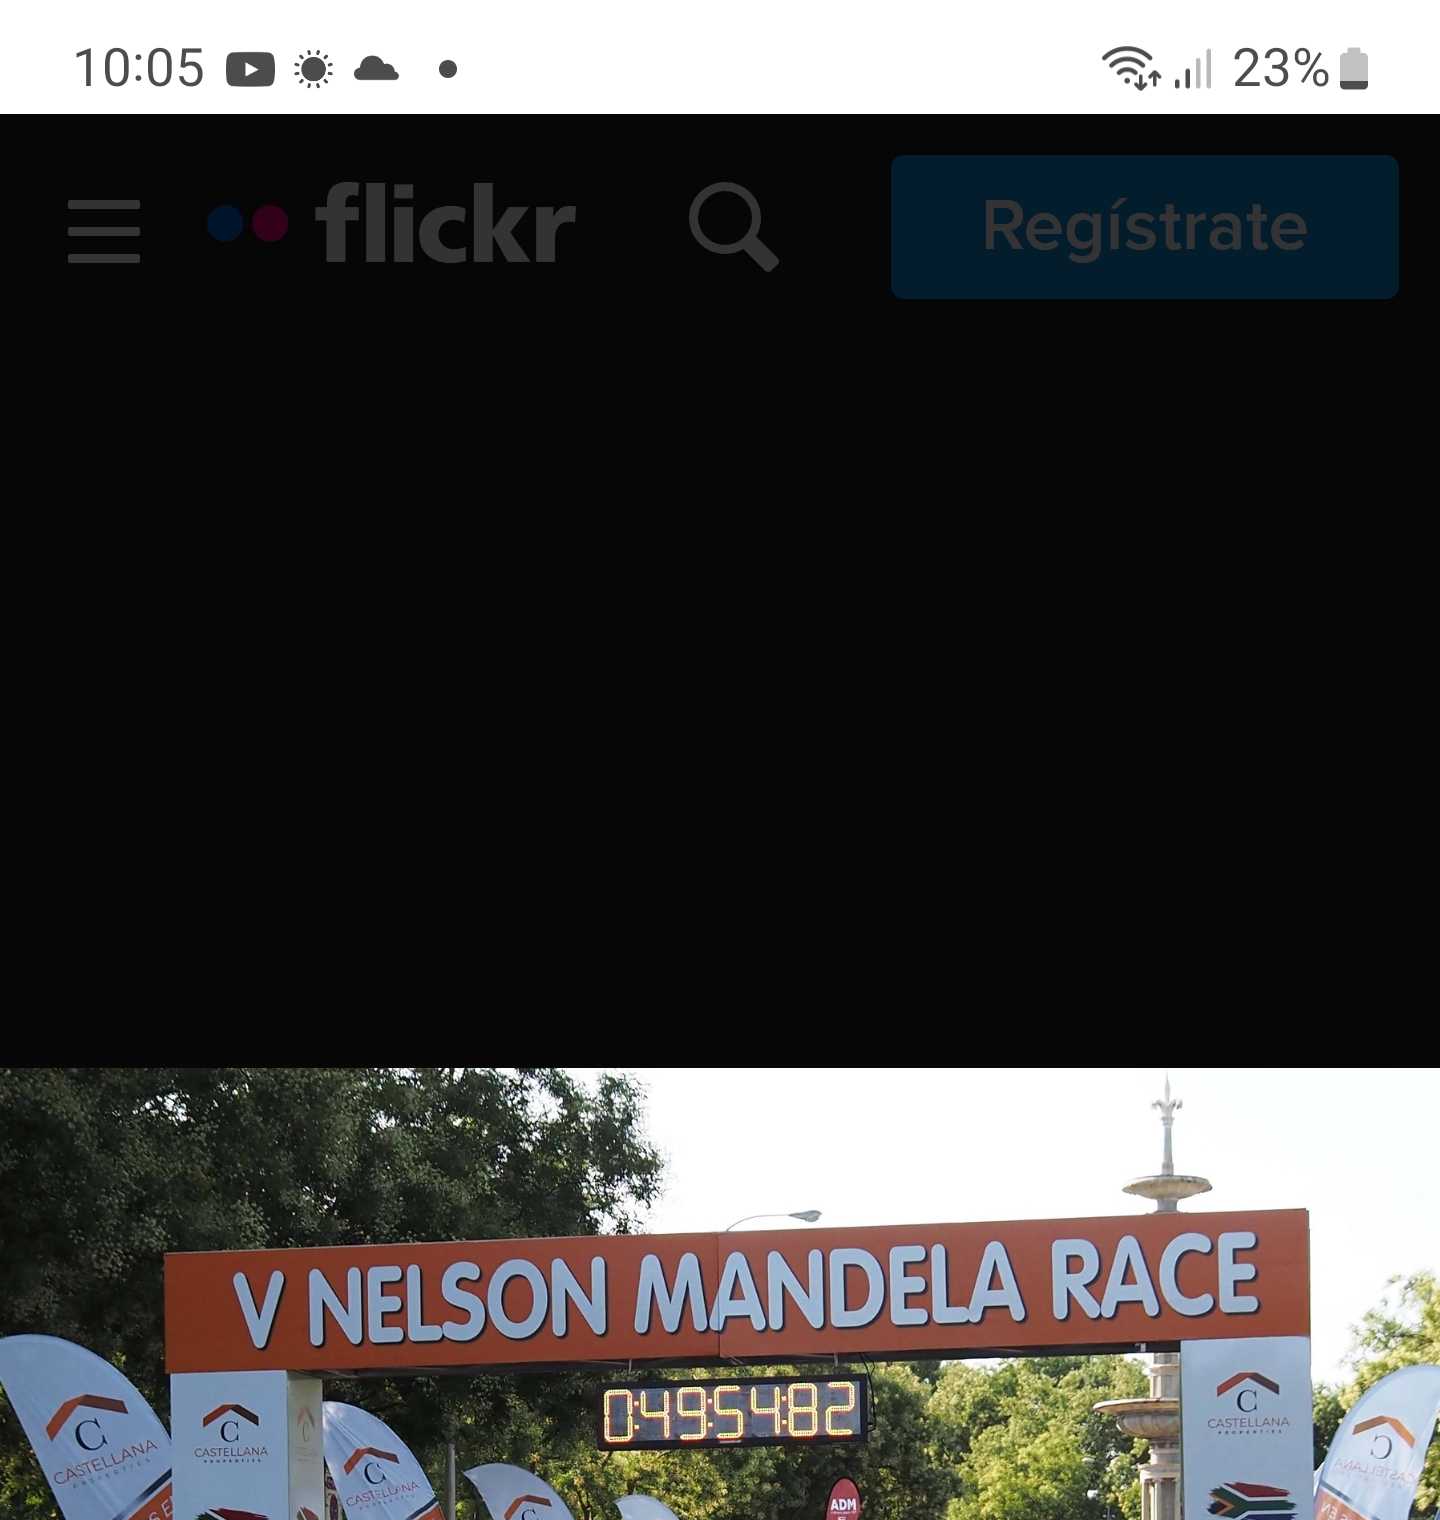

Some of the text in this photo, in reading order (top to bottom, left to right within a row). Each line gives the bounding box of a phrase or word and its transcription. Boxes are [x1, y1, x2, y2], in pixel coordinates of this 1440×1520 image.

[233, 1231, 1260, 1349] V NELSON MANDELA RACE
[603, 1380, 856, 1442] 0:49:54:82
[1207, 1416, 1290, 1429] CASTELLANA
[53, 1439, 158, 1485] CASTELLANA
[194, 1446, 269, 1458] CASTELLANA
[345, 1481, 421, 1507] CASTELLANA
[831, 1498, 857, 1511] ADM
[161, 1495, 173, 1518] E
